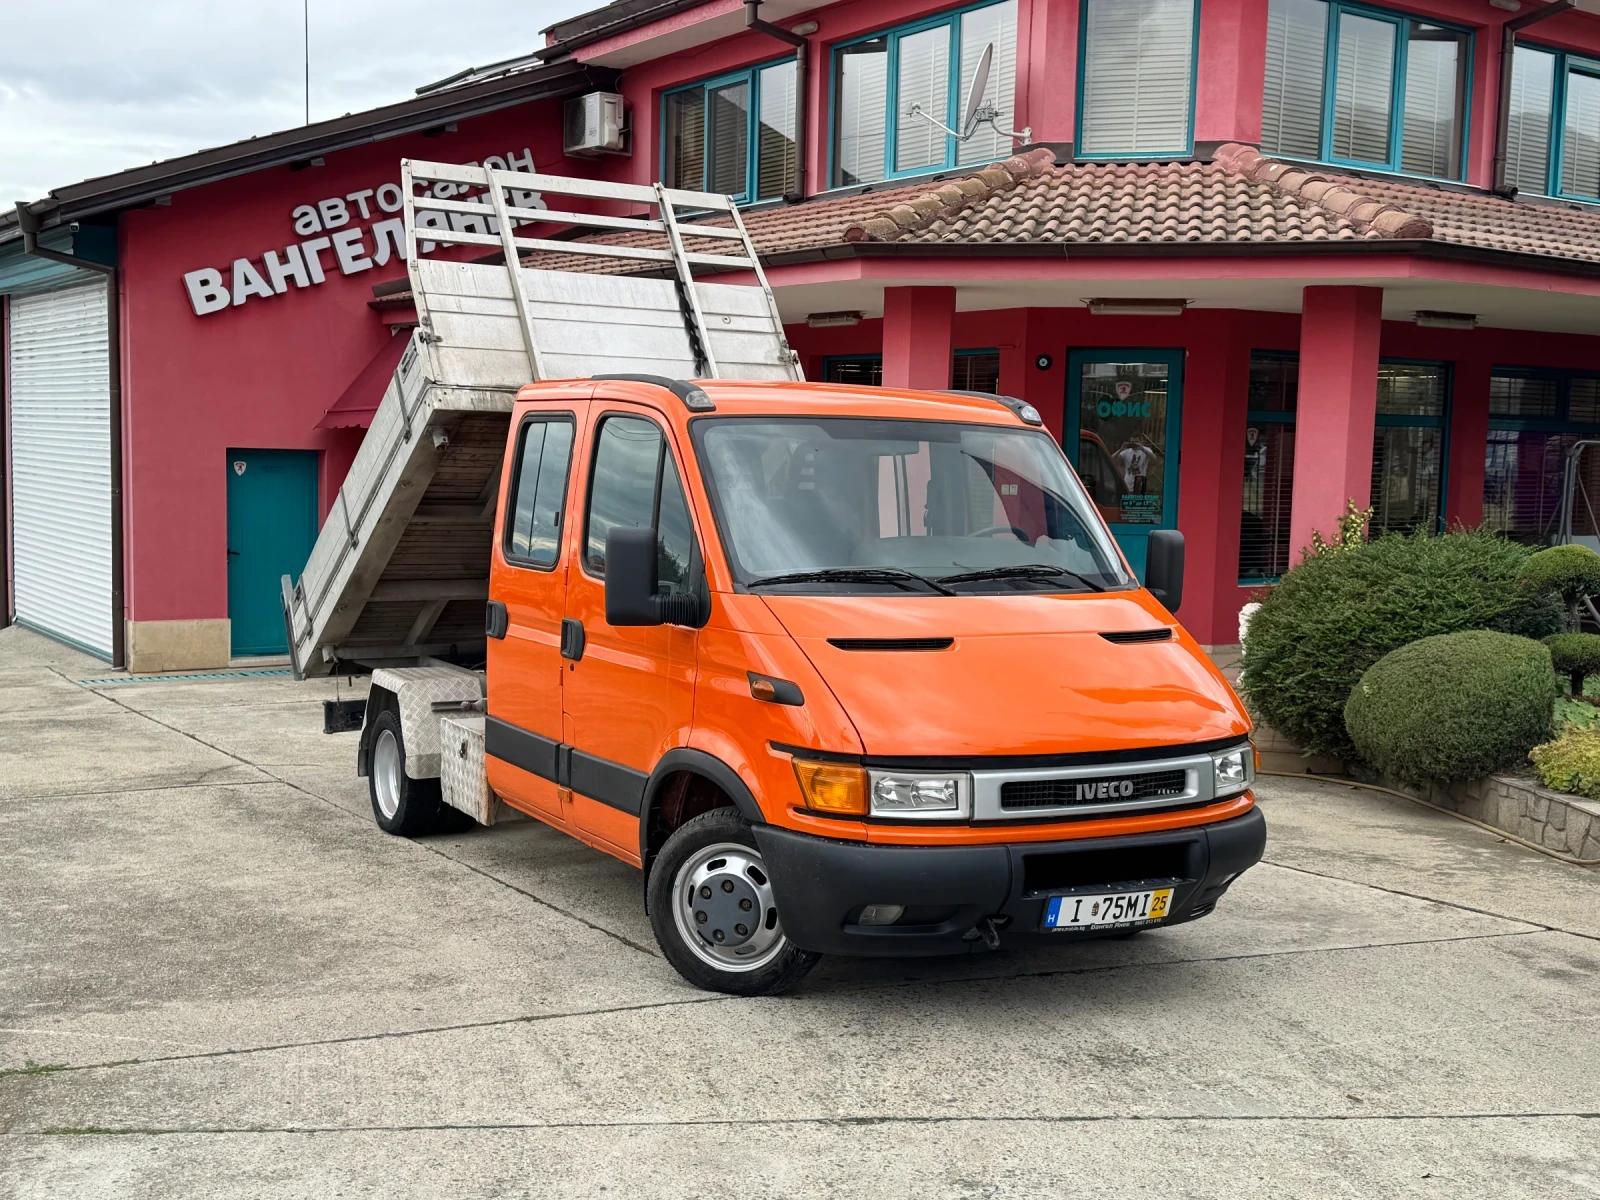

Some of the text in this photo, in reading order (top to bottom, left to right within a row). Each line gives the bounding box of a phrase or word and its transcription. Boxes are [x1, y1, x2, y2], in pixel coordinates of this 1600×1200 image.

[291, 148, 536, 235] автоаон
[1097, 400, 1151, 418] ОФИС
[1076, 780, 1134, 800] IVECO
[1152, 895, 1168, 911] 25
[1047, 914, 1055, 923] H
